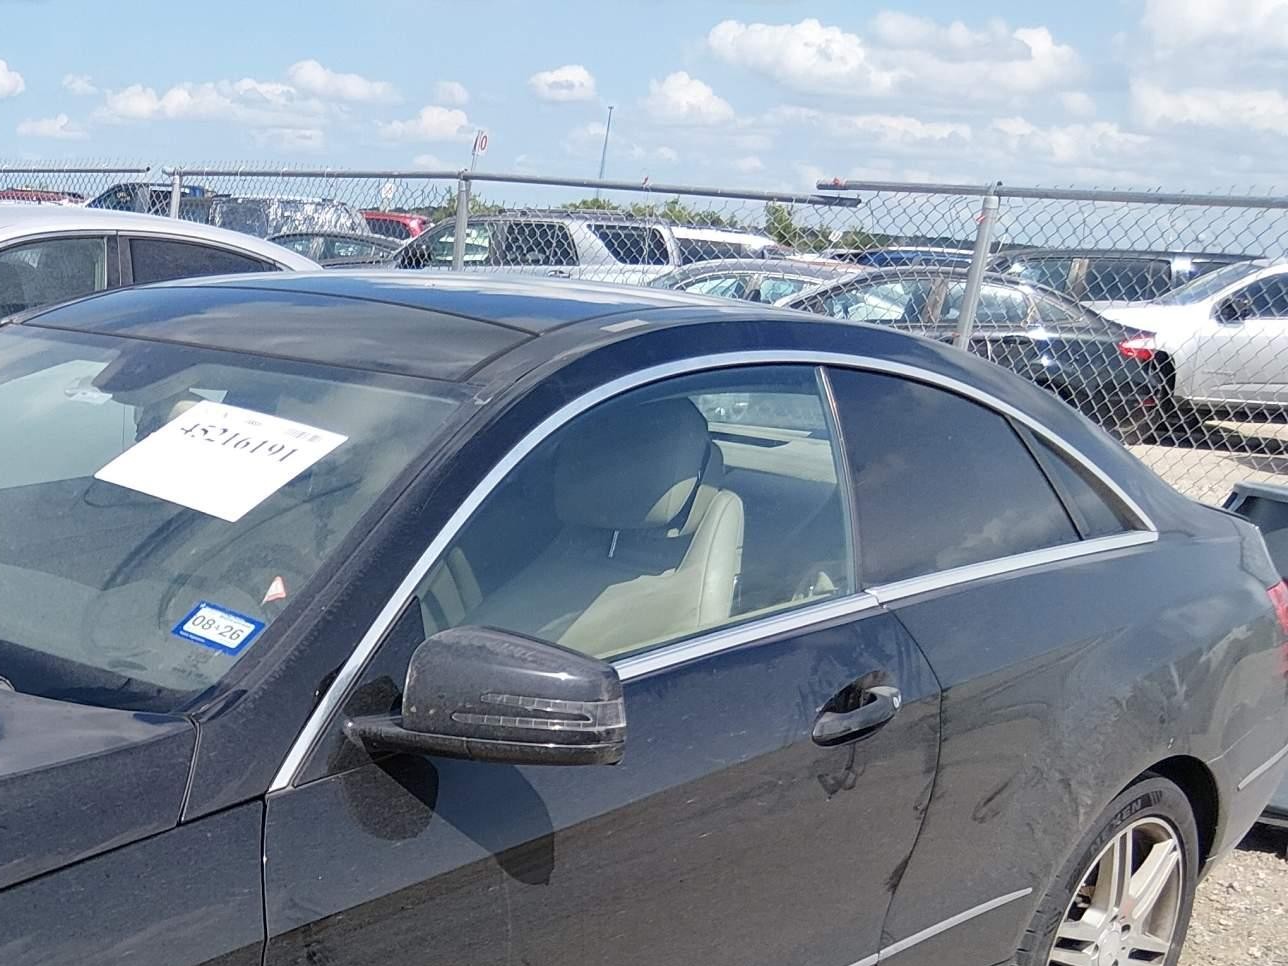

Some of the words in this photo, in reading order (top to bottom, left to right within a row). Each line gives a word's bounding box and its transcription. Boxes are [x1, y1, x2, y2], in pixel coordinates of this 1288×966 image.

[180, 423, 299, 463] 45216191
[192, 615, 216, 630] 08
[218, 625, 244, 641] 26
